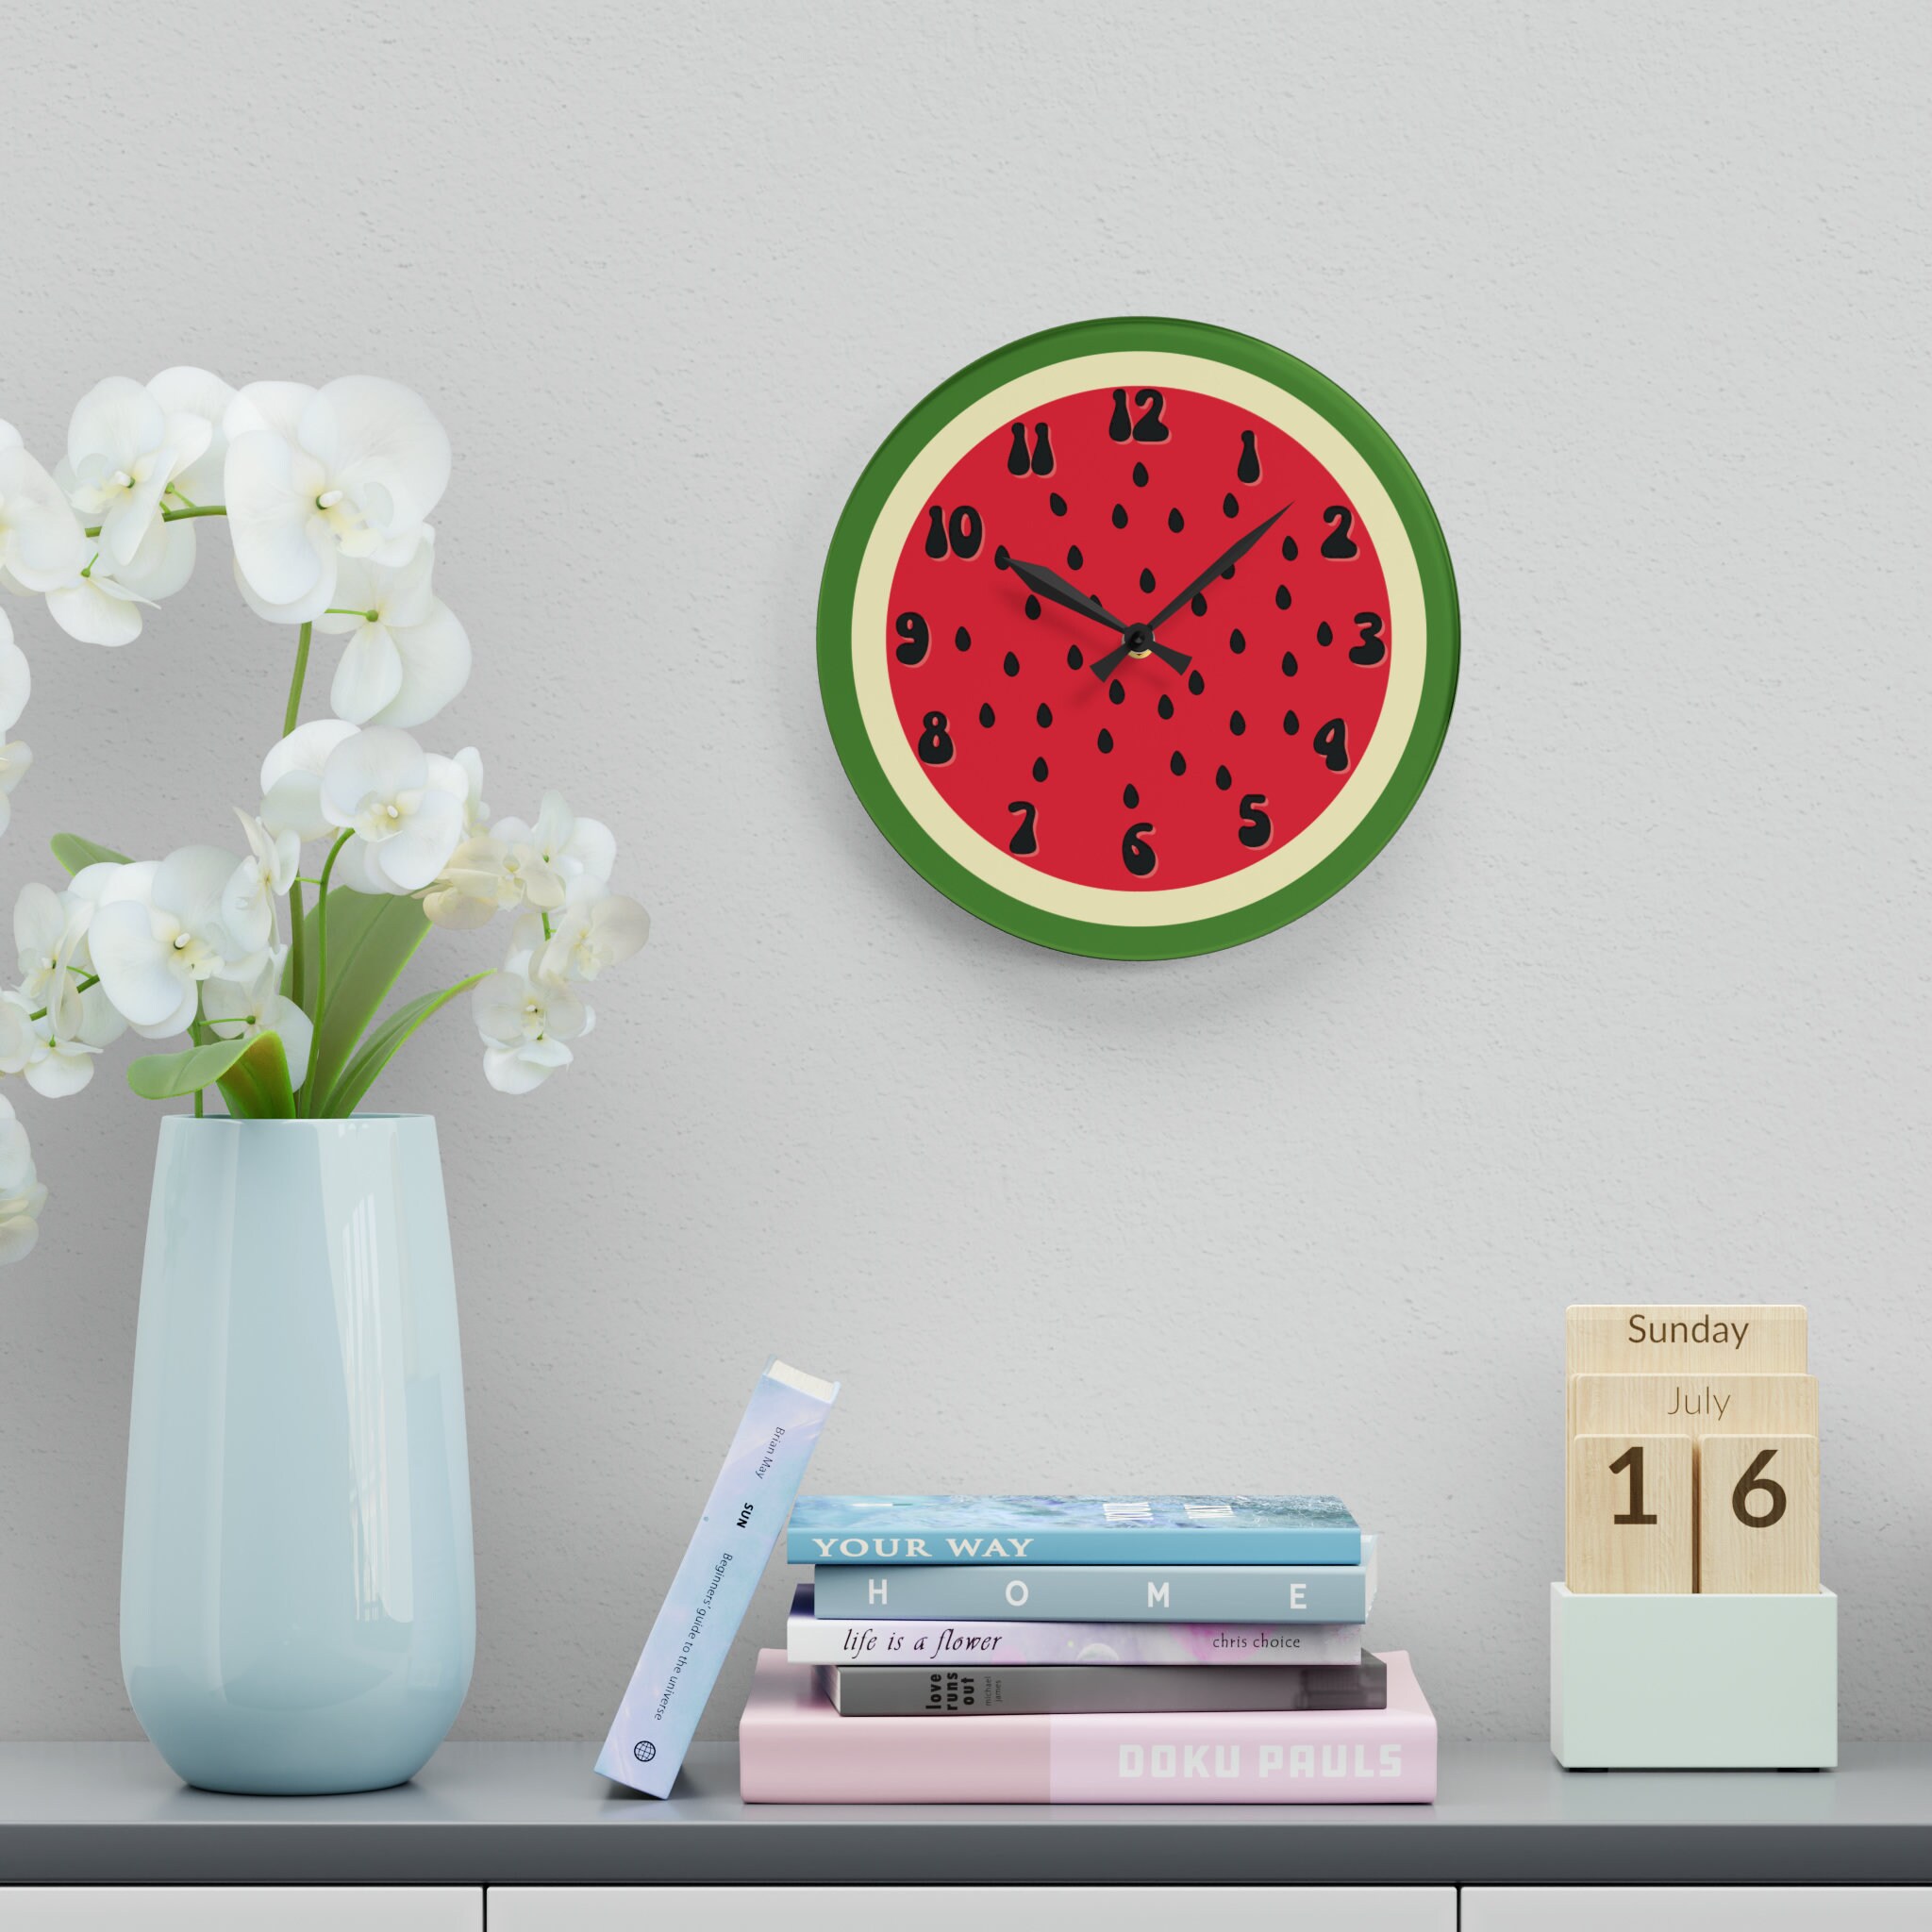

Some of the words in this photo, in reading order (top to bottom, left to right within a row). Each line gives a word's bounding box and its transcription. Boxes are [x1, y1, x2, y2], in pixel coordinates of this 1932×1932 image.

[1109, 389, 1170, 443] 12
[1008, 422, 1055, 477] 11
[1237, 430, 1261, 485] 1
[925, 505, 984, 560] 10
[1321, 505, 1358, 560] 2
[895, 611, 930, 666] 9
[1348, 612, 1387, 666] 3
[918, 710, 955, 766] 8
[1313, 718, 1349, 773] 4
[1008, 801, 1039, 856] 7
[1238, 793, 1272, 849] 5
[1122, 823, 1157, 877] 6
[1627, 1313, 1750, 1351] Sunday
[1667, 1386, 1731, 1422] July
[766, 1425, 786, 1455] Brian
[755, 1456, 774, 1480] May
[736, 1502, 754, 1529] SUN
[811, 1538, 933, 1557] YOUR
[945, 1538, 1035, 1557] WAY
[688, 1607, 708, 1640] guide
[1212, 1633, 1248, 1649] chris
[1252, 1633, 1301, 1649] choice
[682, 1641, 693, 1653] to
[842, 1628, 878, 1659] life
[887, 1632, 905, 1651] is
[912, 1636, 928, 1651] a
[929, 1628, 1004, 1659] flower
[673, 1656, 689, 1674] the
[654, 1676, 679, 1721] universe
[925, 1674, 941, 1709] love
[946, 1672, 958, 1711] runs
[960, 1677, 974, 1706] out
[1118, 1744, 1241, 1778] DOKU
[1258, 1744, 1403, 1778] PAULS
